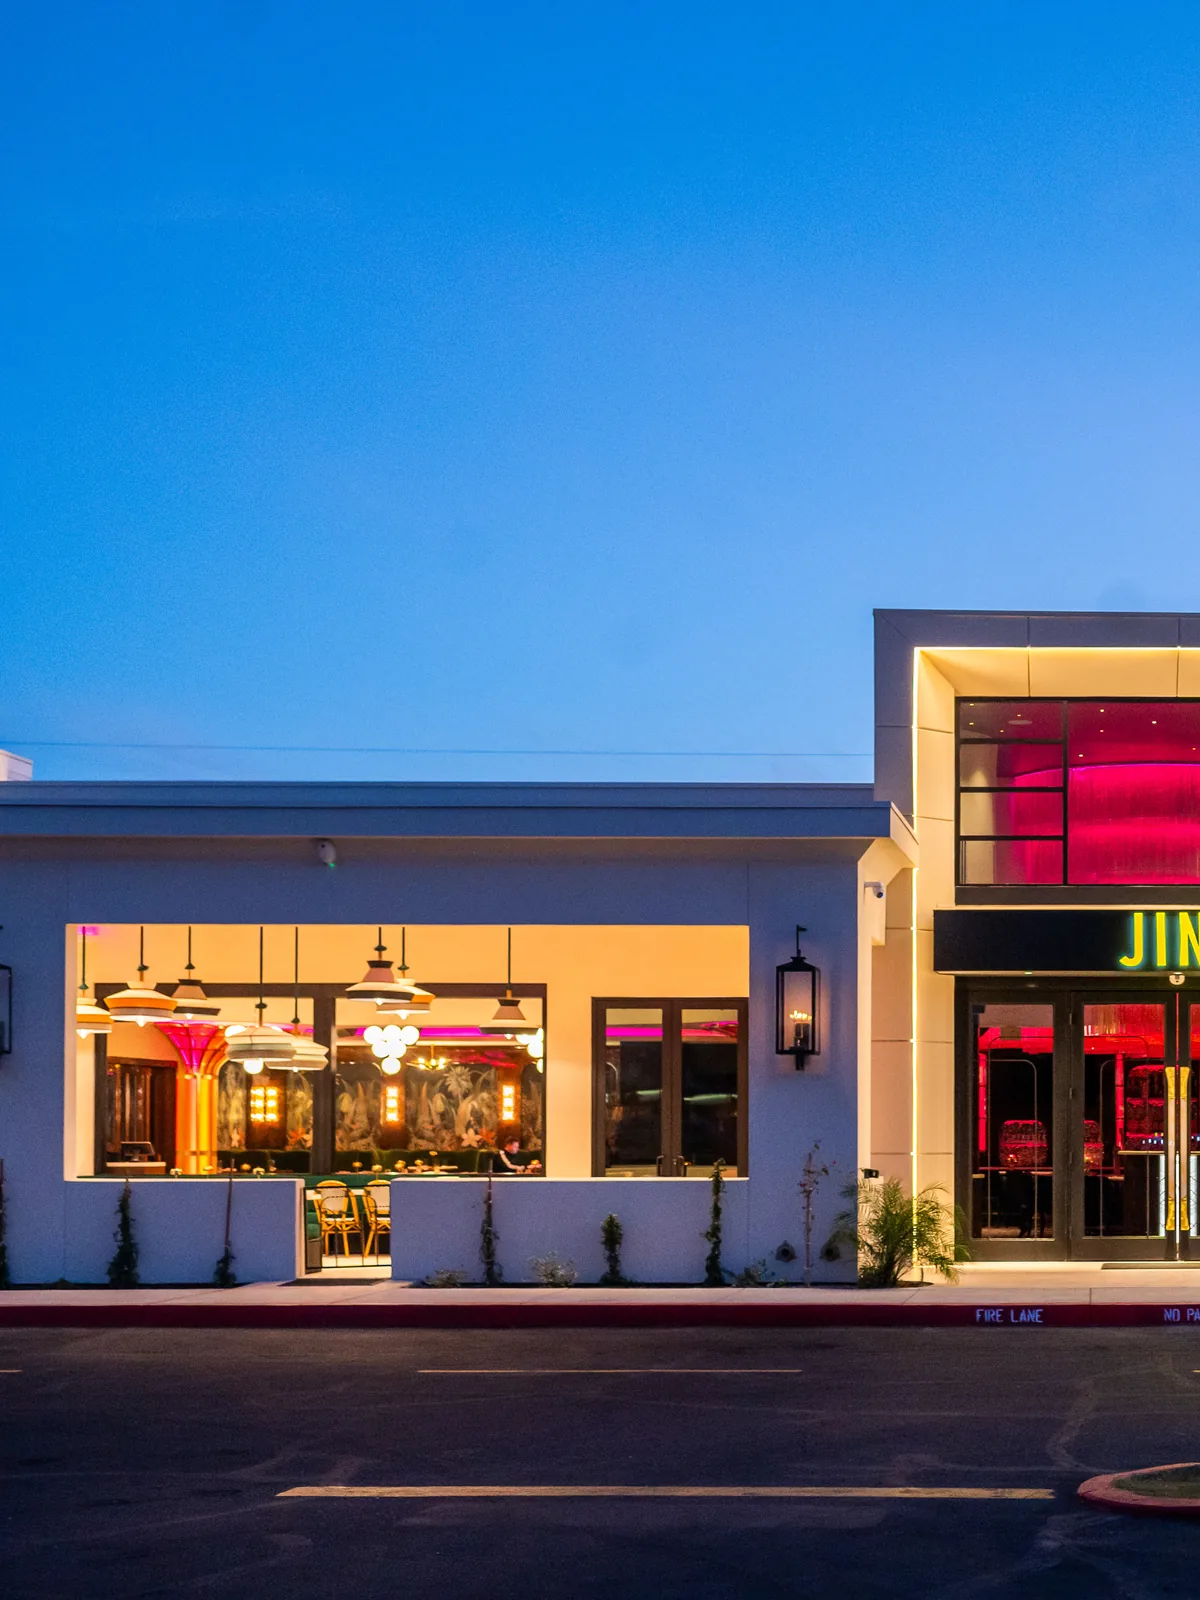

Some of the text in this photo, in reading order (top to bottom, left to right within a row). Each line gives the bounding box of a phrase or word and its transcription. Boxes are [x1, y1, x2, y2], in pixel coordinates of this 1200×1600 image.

[975, 1308, 1044, 1323] FIRE LANE
[1163, 1308, 1181, 1322] NO
